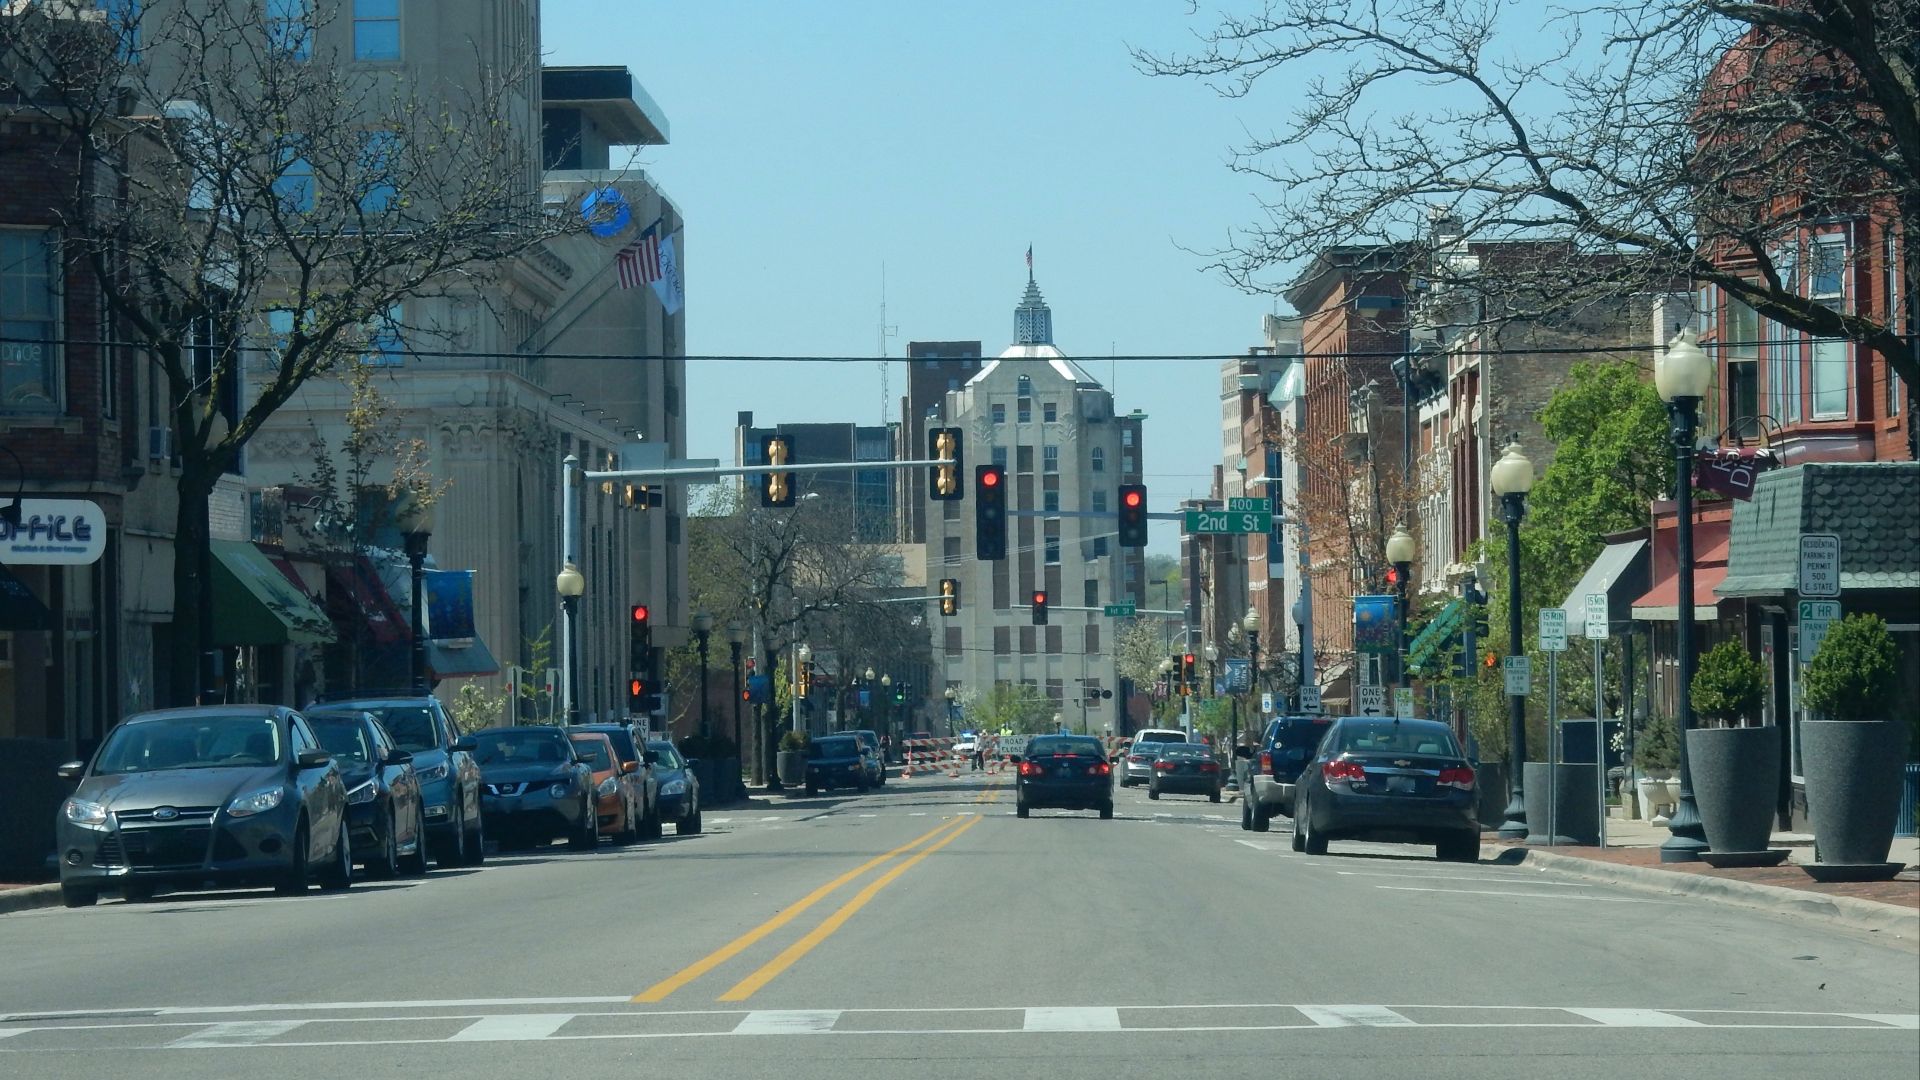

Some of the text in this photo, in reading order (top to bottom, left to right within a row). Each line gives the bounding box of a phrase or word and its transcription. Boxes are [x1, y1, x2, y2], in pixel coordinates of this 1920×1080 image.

[1230, 499, 1269, 511] 400 E
[1197, 513, 1260, 531] 2nd St
[1803, 552, 1826, 560] PARKING
[1807, 562, 1831, 570] PERMIT
[1811, 572, 1826, 580] 500
[1813, 583, 1833, 591] STATE
[1587, 597, 1605, 606] 15 MIN
[1801, 603, 1832, 619] 2 HR
[1542, 612, 1564, 621] 15 MIN
[1302, 687, 1319, 695] ONE
[1361, 688, 1381, 696] ONE
[1361, 697, 1381, 705] WAY
